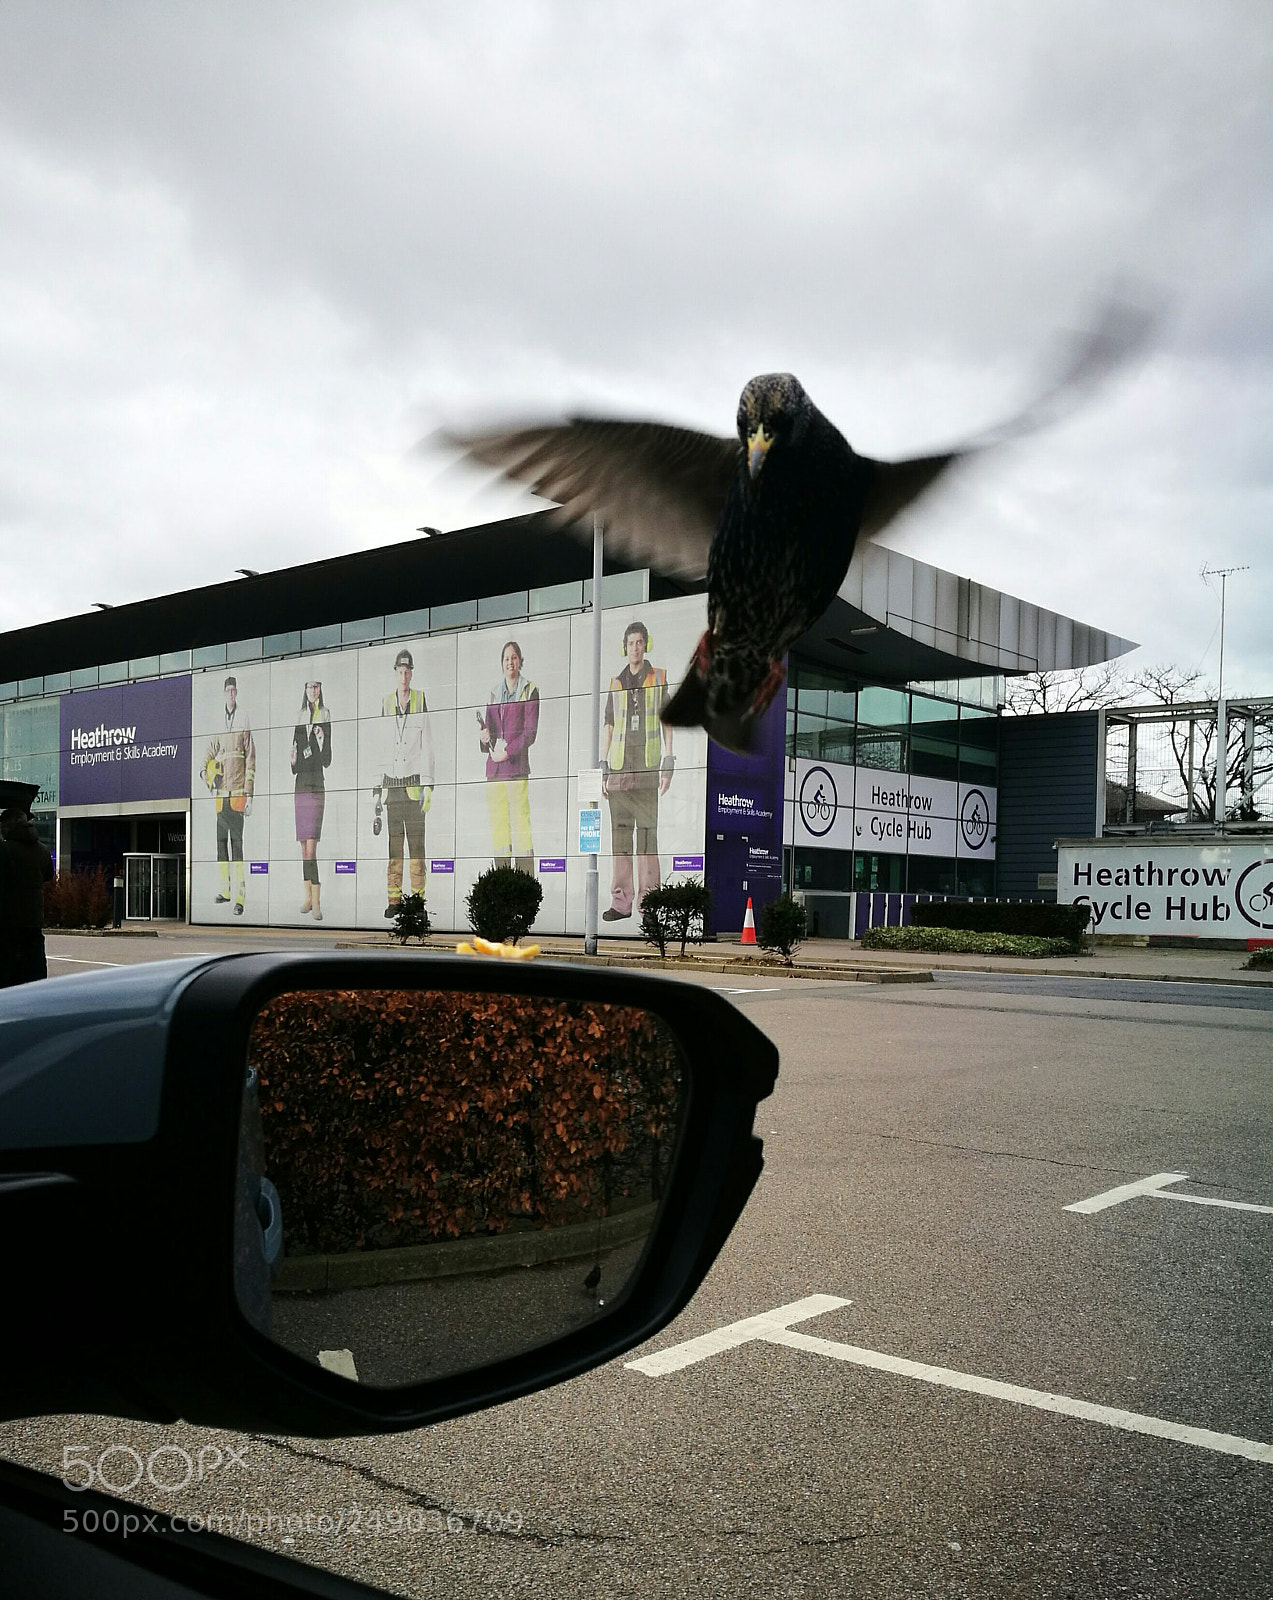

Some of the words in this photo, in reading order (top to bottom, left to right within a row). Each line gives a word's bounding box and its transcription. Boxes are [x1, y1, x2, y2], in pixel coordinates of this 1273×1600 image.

[71, 723, 136, 750] Heathrow
[70, 749, 114, 767] Employment
[115, 748, 122, 760] &
[123, 746, 140, 760] Skills
[141, 743, 178, 759] Academy
[718, 793, 754, 808] Heathrow
[871, 785, 933, 812] Heathrow
[870, 816, 903, 841] Cycle
[908, 818, 932, 841] Hub
[1073, 860, 1232, 887] Heathrow
[1165, 895, 1231, 921] Hub
